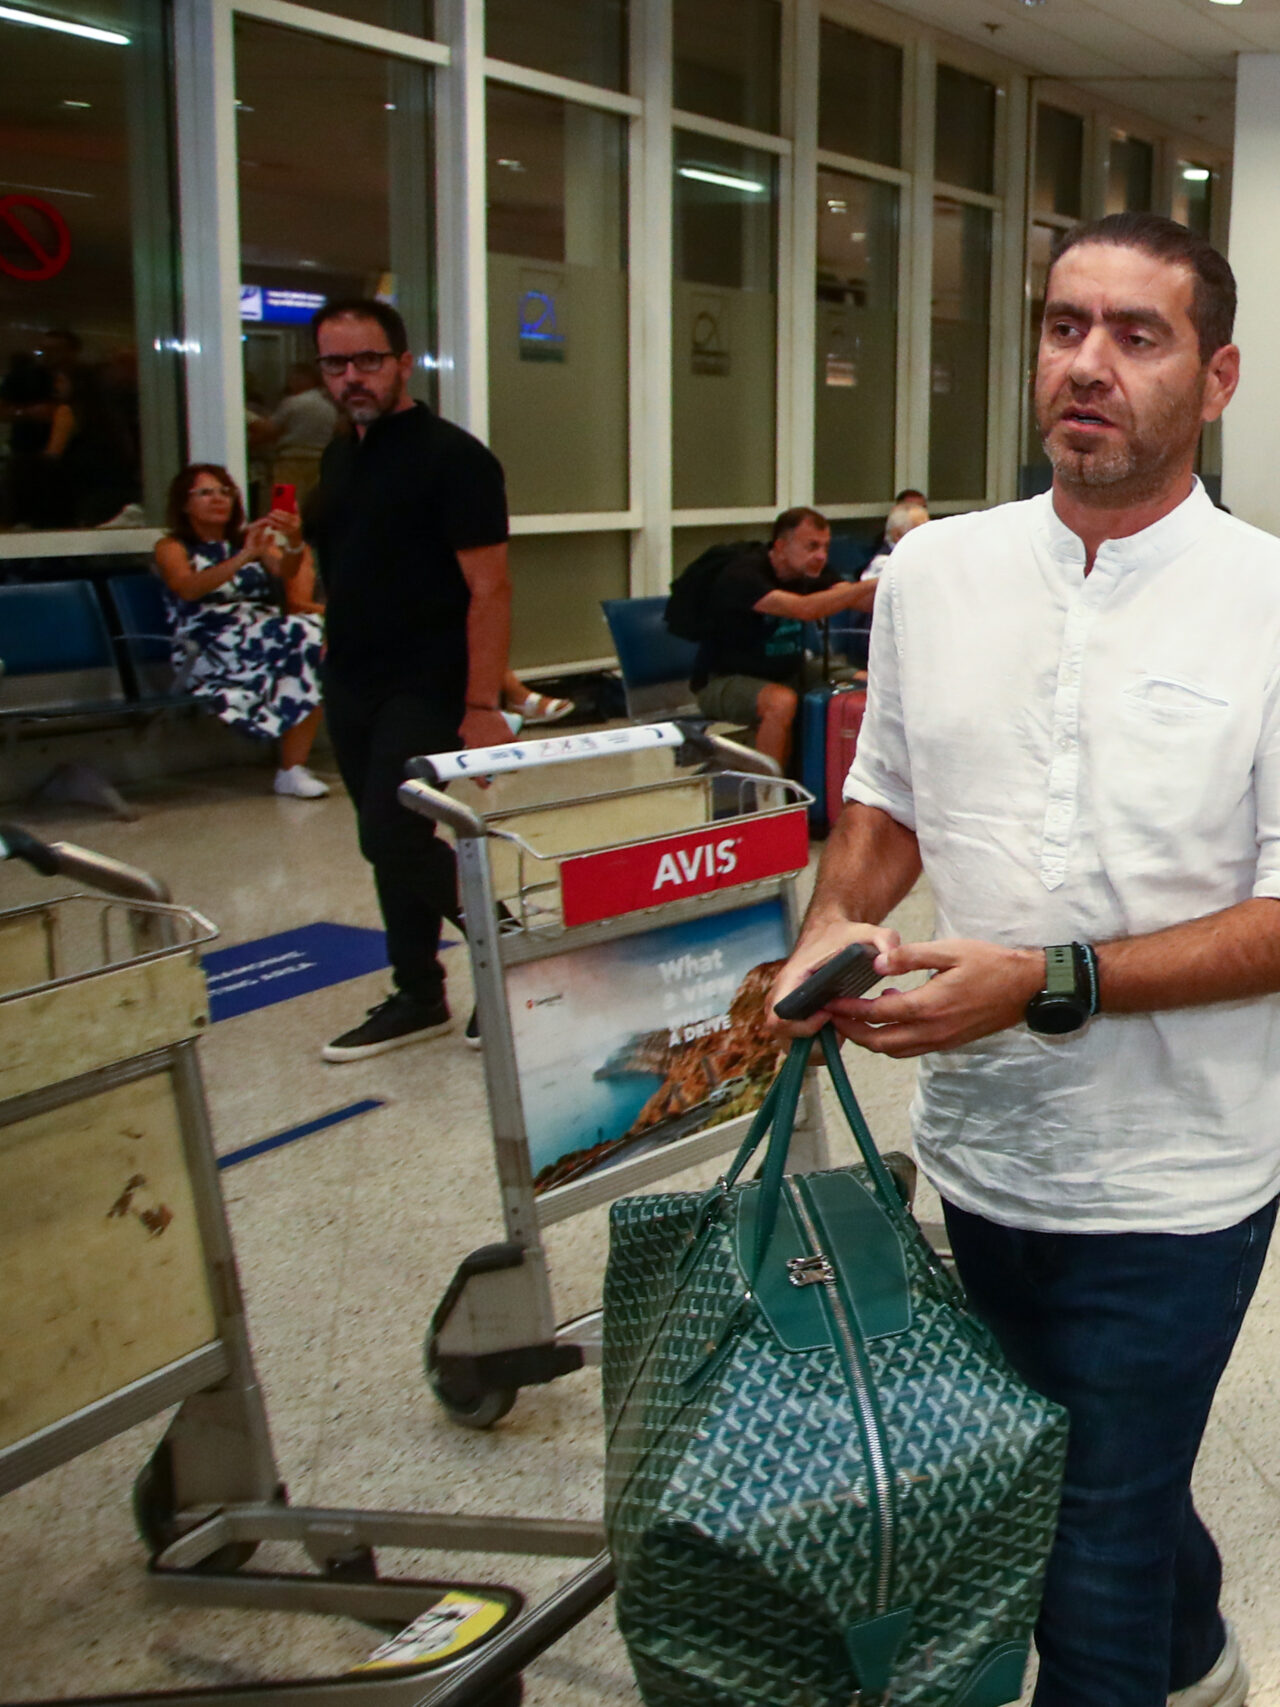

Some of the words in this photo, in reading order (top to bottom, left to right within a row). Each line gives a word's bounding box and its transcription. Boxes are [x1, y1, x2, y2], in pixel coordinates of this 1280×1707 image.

[652, 838, 738, 891] AVIS
[658, 948, 724, 984] What
[668, 1029, 683, 1049] A
[684, 1014, 732, 1043] DRIVE
